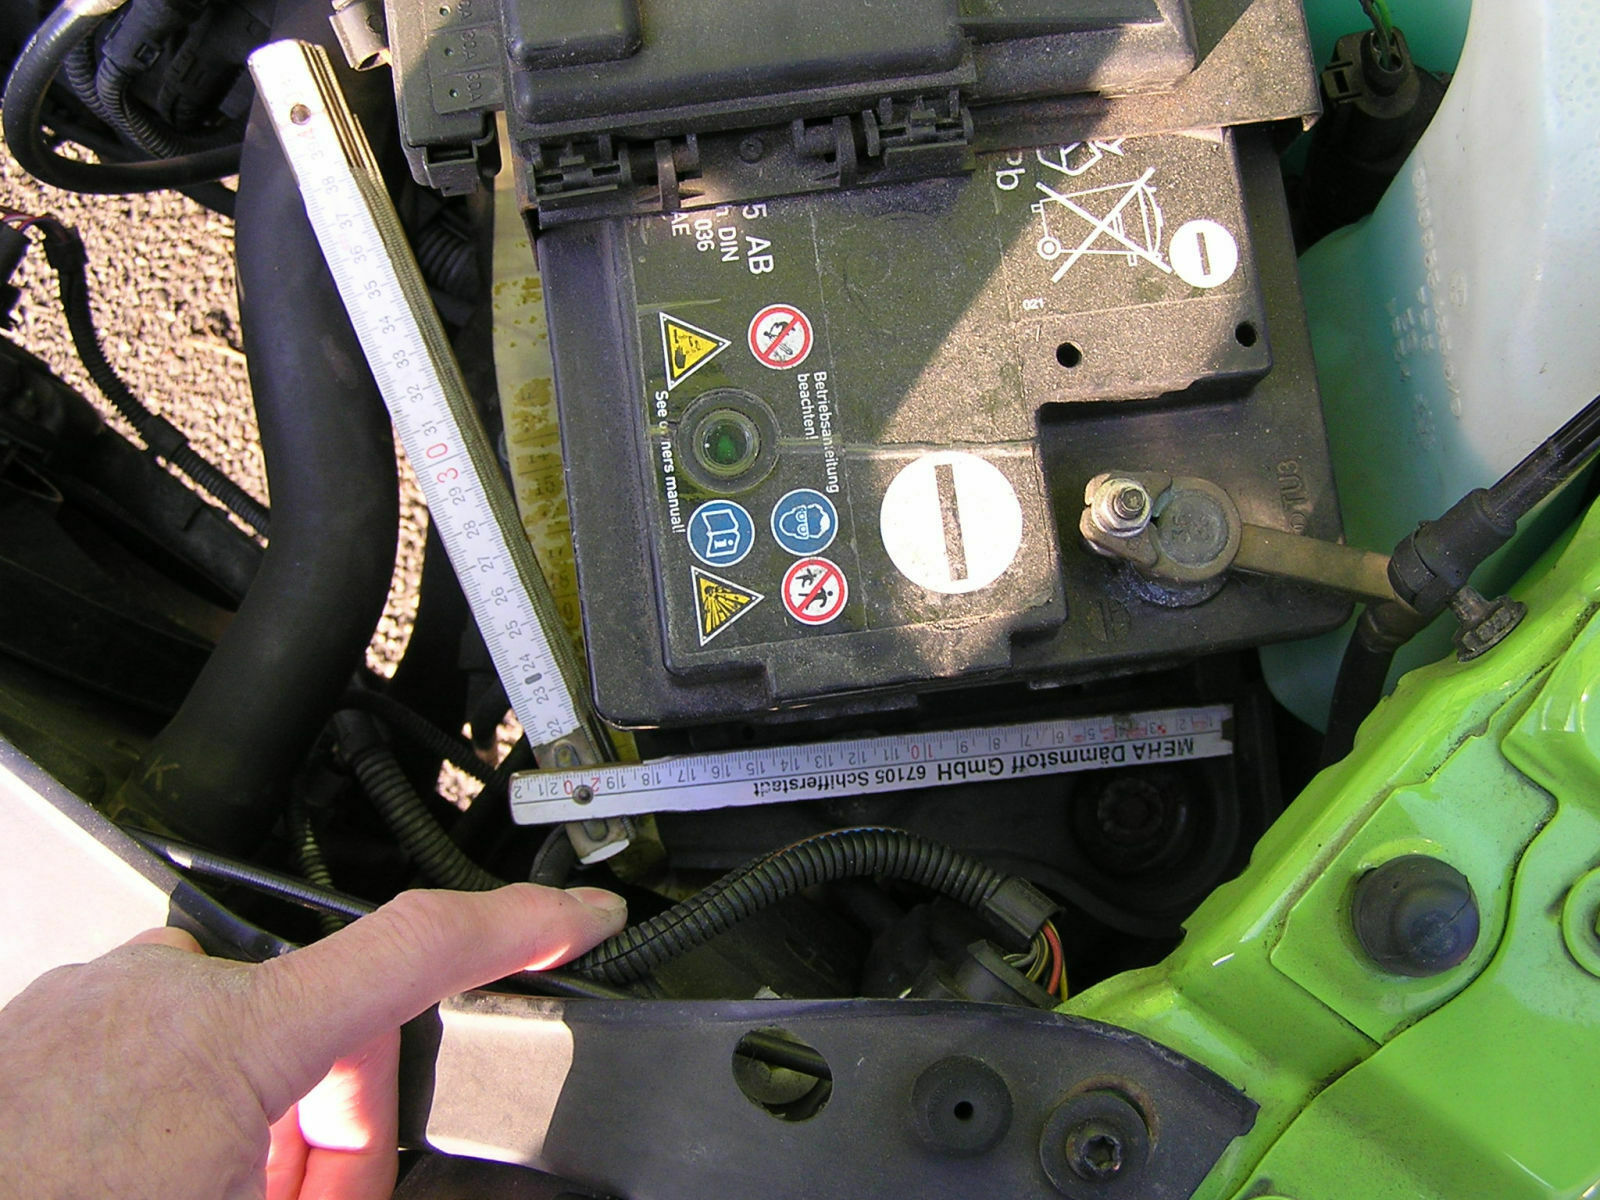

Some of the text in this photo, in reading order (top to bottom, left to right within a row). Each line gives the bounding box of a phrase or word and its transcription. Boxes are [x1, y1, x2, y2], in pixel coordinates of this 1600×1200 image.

[321, 176, 338, 195] 38
[334, 213, 352, 230] 37
[694, 219, 714, 252] 036
[718, 227, 740, 262] DIN
[352, 246, 368, 264] 36
[746, 234, 774, 274] AB
[365, 280, 382, 299] 35
[382, 315, 396, 334] 34
[393, 350, 410, 368] 33
[406, 386, 424, 403] 32
[798, 373, 817, 440] beachten!
[422, 420, 438, 436] 31
[655, 391, 668, 417] See
[666, 476, 684, 534] manual!
[449, 488, 466, 506] 29
[464, 520, 480, 538] 28
[478, 557, 494, 572] 27
[491, 588, 508, 606] 26
[505, 620, 522, 639] 25
[521, 654, 536, 670] 24
[537, 686, 550, 705] 23
[550, 719, 562, 737] 22
[1088, 727, 1096, 740] 5
[992, 736, 1000, 750] 8
[1024, 733, 1032, 747] 7
[1058, 730, 1064, 744] 6
[911, 743, 933, 760] 10
[960, 740, 968, 754] 9
[754, 736, 1194, 796] MEHA Dämmstoff GmbH 67105 Schifferstadt
[780, 758, 800, 772] 14
[814, 754, 834, 768] 13
[848, 750, 868, 766] 12
[676, 769, 696, 784] 17
[712, 764, 730, 779] 16
[746, 762, 765, 776] 15
[607, 775, 626, 790] 19
[642, 772, 661, 787] 18
[538, 782, 558, 796] 21
